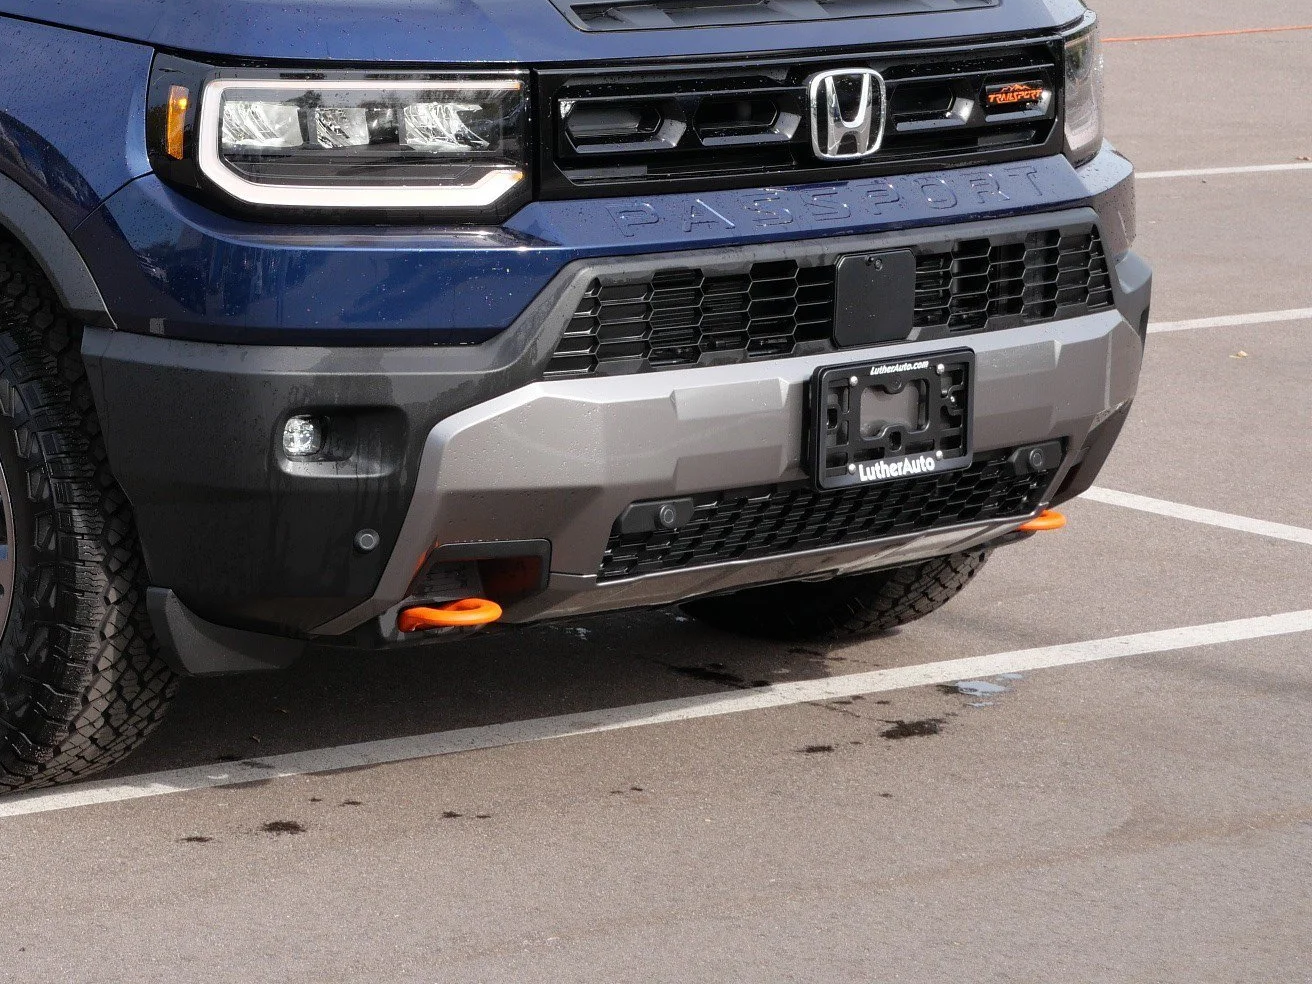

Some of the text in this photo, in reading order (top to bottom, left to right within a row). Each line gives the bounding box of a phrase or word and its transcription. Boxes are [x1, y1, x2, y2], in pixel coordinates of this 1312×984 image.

[988, 88, 1043, 104] TRAILSPORT
[605, 164, 1043, 238] PASSPORT
[870, 360, 930, 376] LutherAuto.com
[858, 455, 936, 482] LutherAuto
